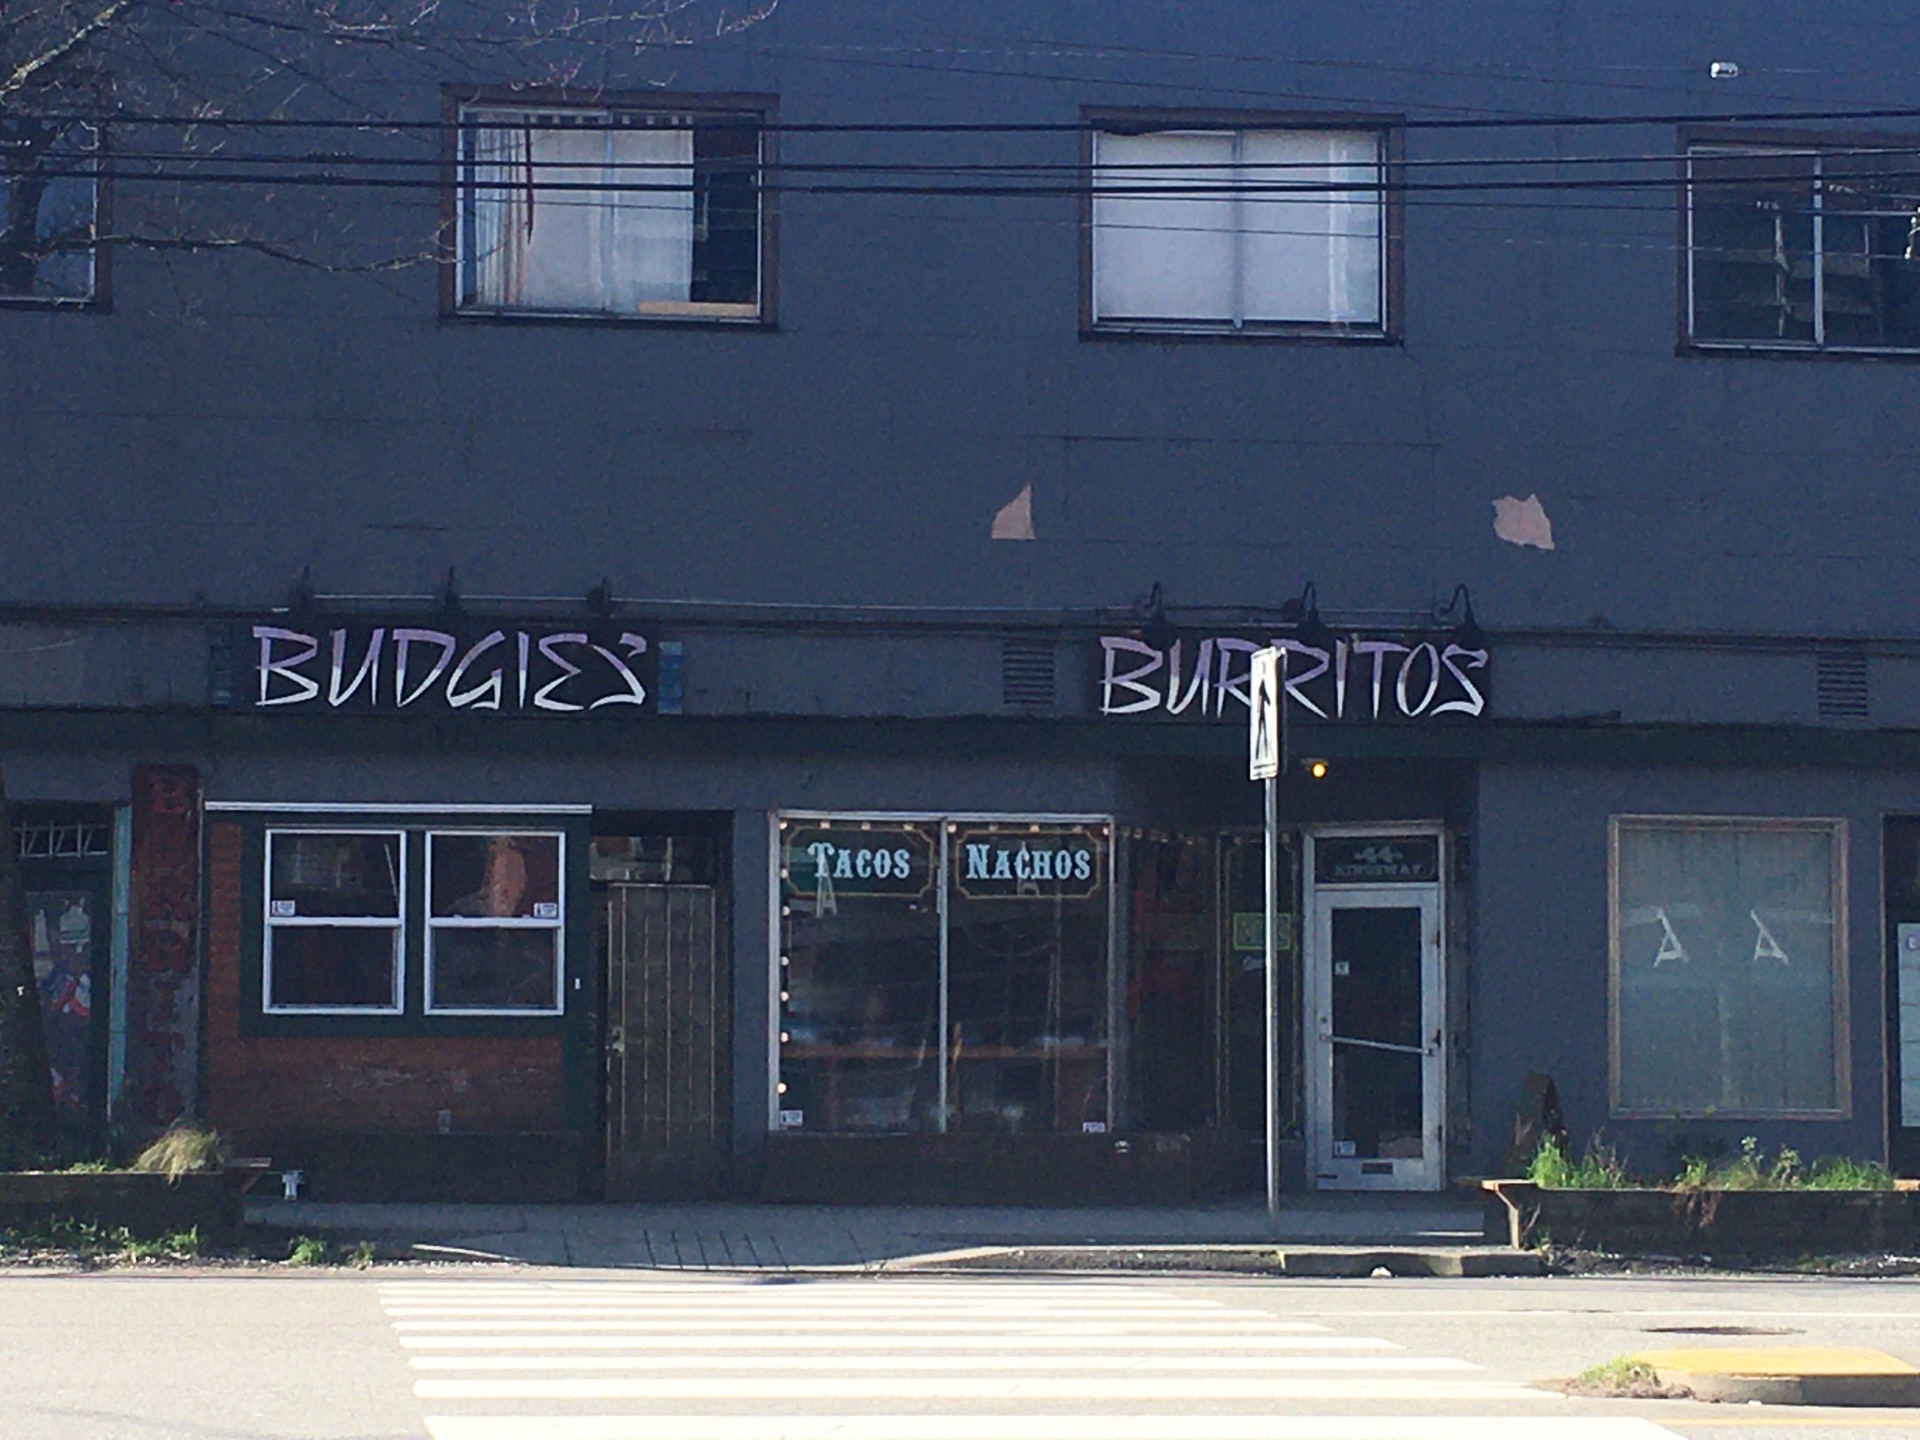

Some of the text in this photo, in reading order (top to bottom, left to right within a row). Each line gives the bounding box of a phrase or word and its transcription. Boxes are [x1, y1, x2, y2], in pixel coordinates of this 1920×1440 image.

[1098, 636, 1489, 719] BURRITOS
[807, 841, 911, 879] TACOS
[965, 843, 1091, 881] NACHOS
